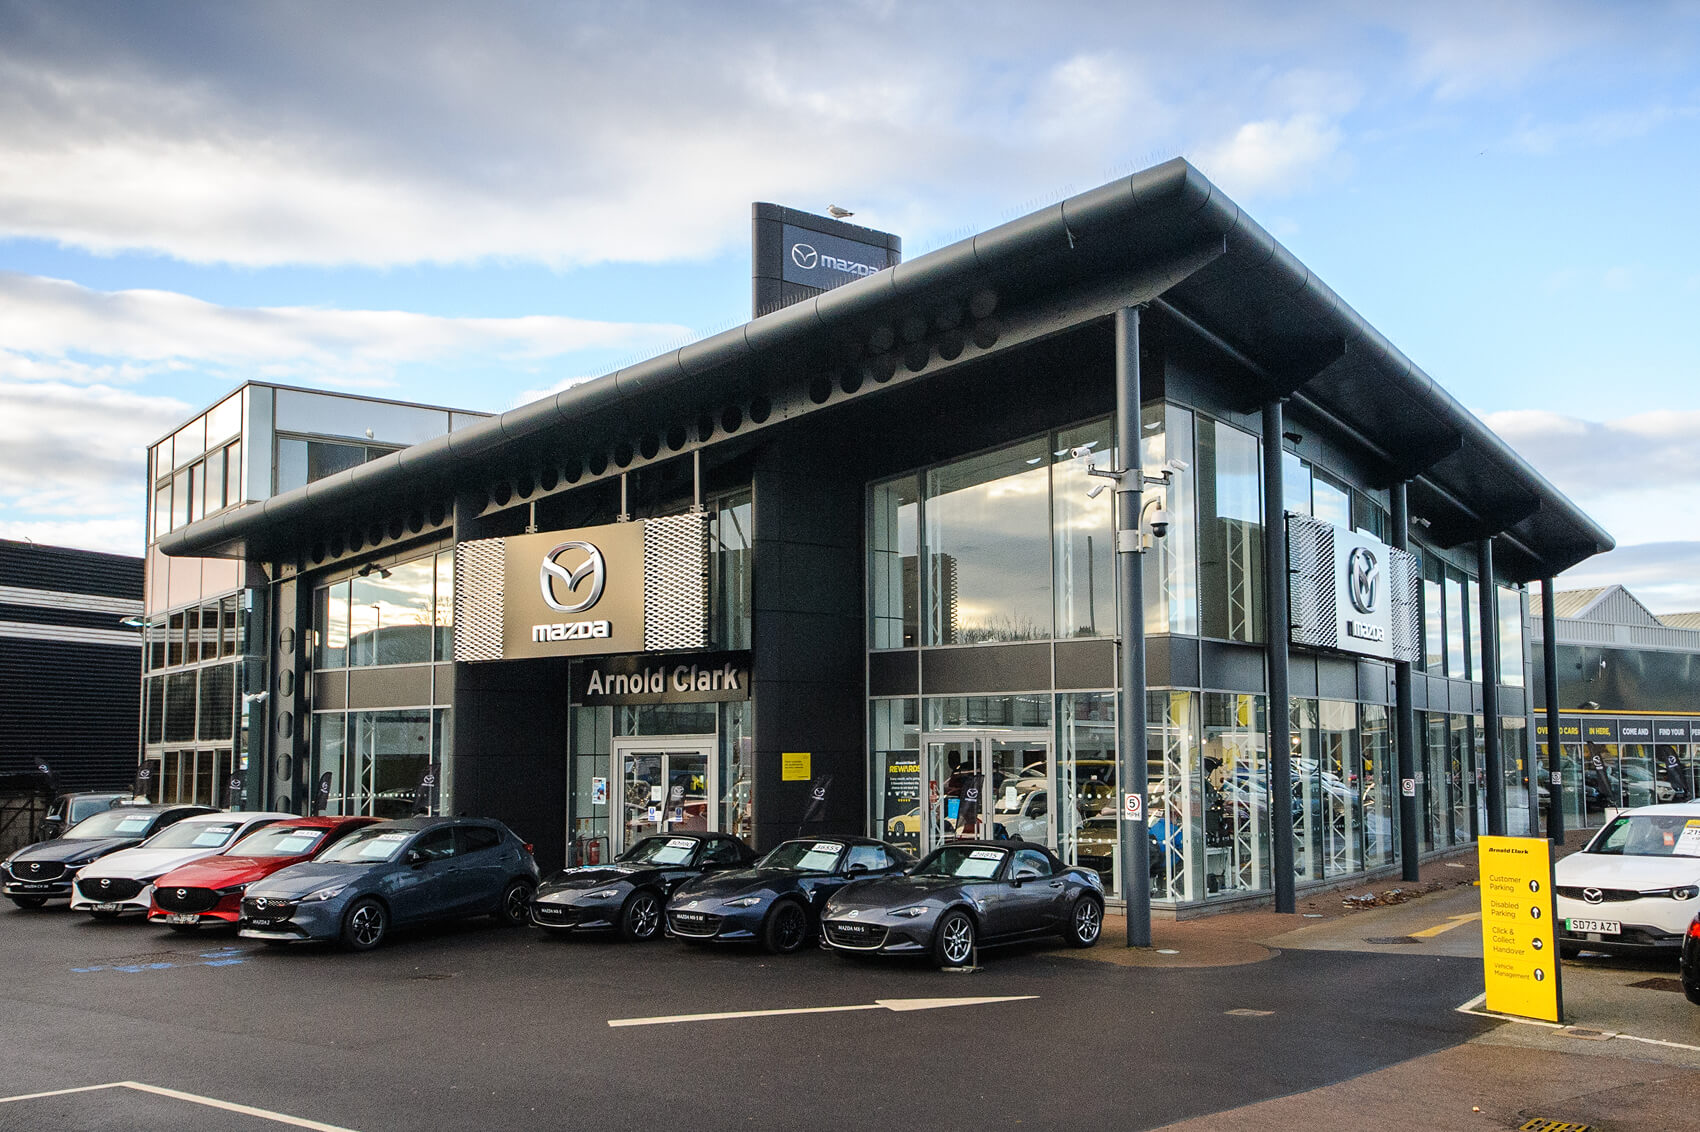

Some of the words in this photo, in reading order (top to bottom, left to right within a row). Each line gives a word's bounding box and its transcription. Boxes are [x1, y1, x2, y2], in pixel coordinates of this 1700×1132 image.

[532, 620, 610, 642] mazda
[1347, 620, 1384, 641] mazda
[587, 666, 665, 695] Arnold
[673, 662, 738, 692] Clark
[1564, 727, 1579, 735] CARS
[1589, 727, 1595, 735] IN
[890, 765, 920, 773] REWARDS
[1130, 799, 1136, 808] 5
[1489, 874, 1521, 883] Customer
[1489, 883, 1515, 893] Parking
[1491, 900, 1520, 910] Disabled
[1491, 909, 1516, 919] Parking
[1492, 926, 1508, 935] Click
[1509, 928, 1514, 936] &
[1572, 921, 1598, 931] SD73
[1600, 922, 1618, 932] AZT
[1492, 935, 1516, 945] Collect
[1493, 946, 1526, 956] Handover
[1494, 962, 1514, 971] Vehicle
[1494, 969, 1530, 980] Management
